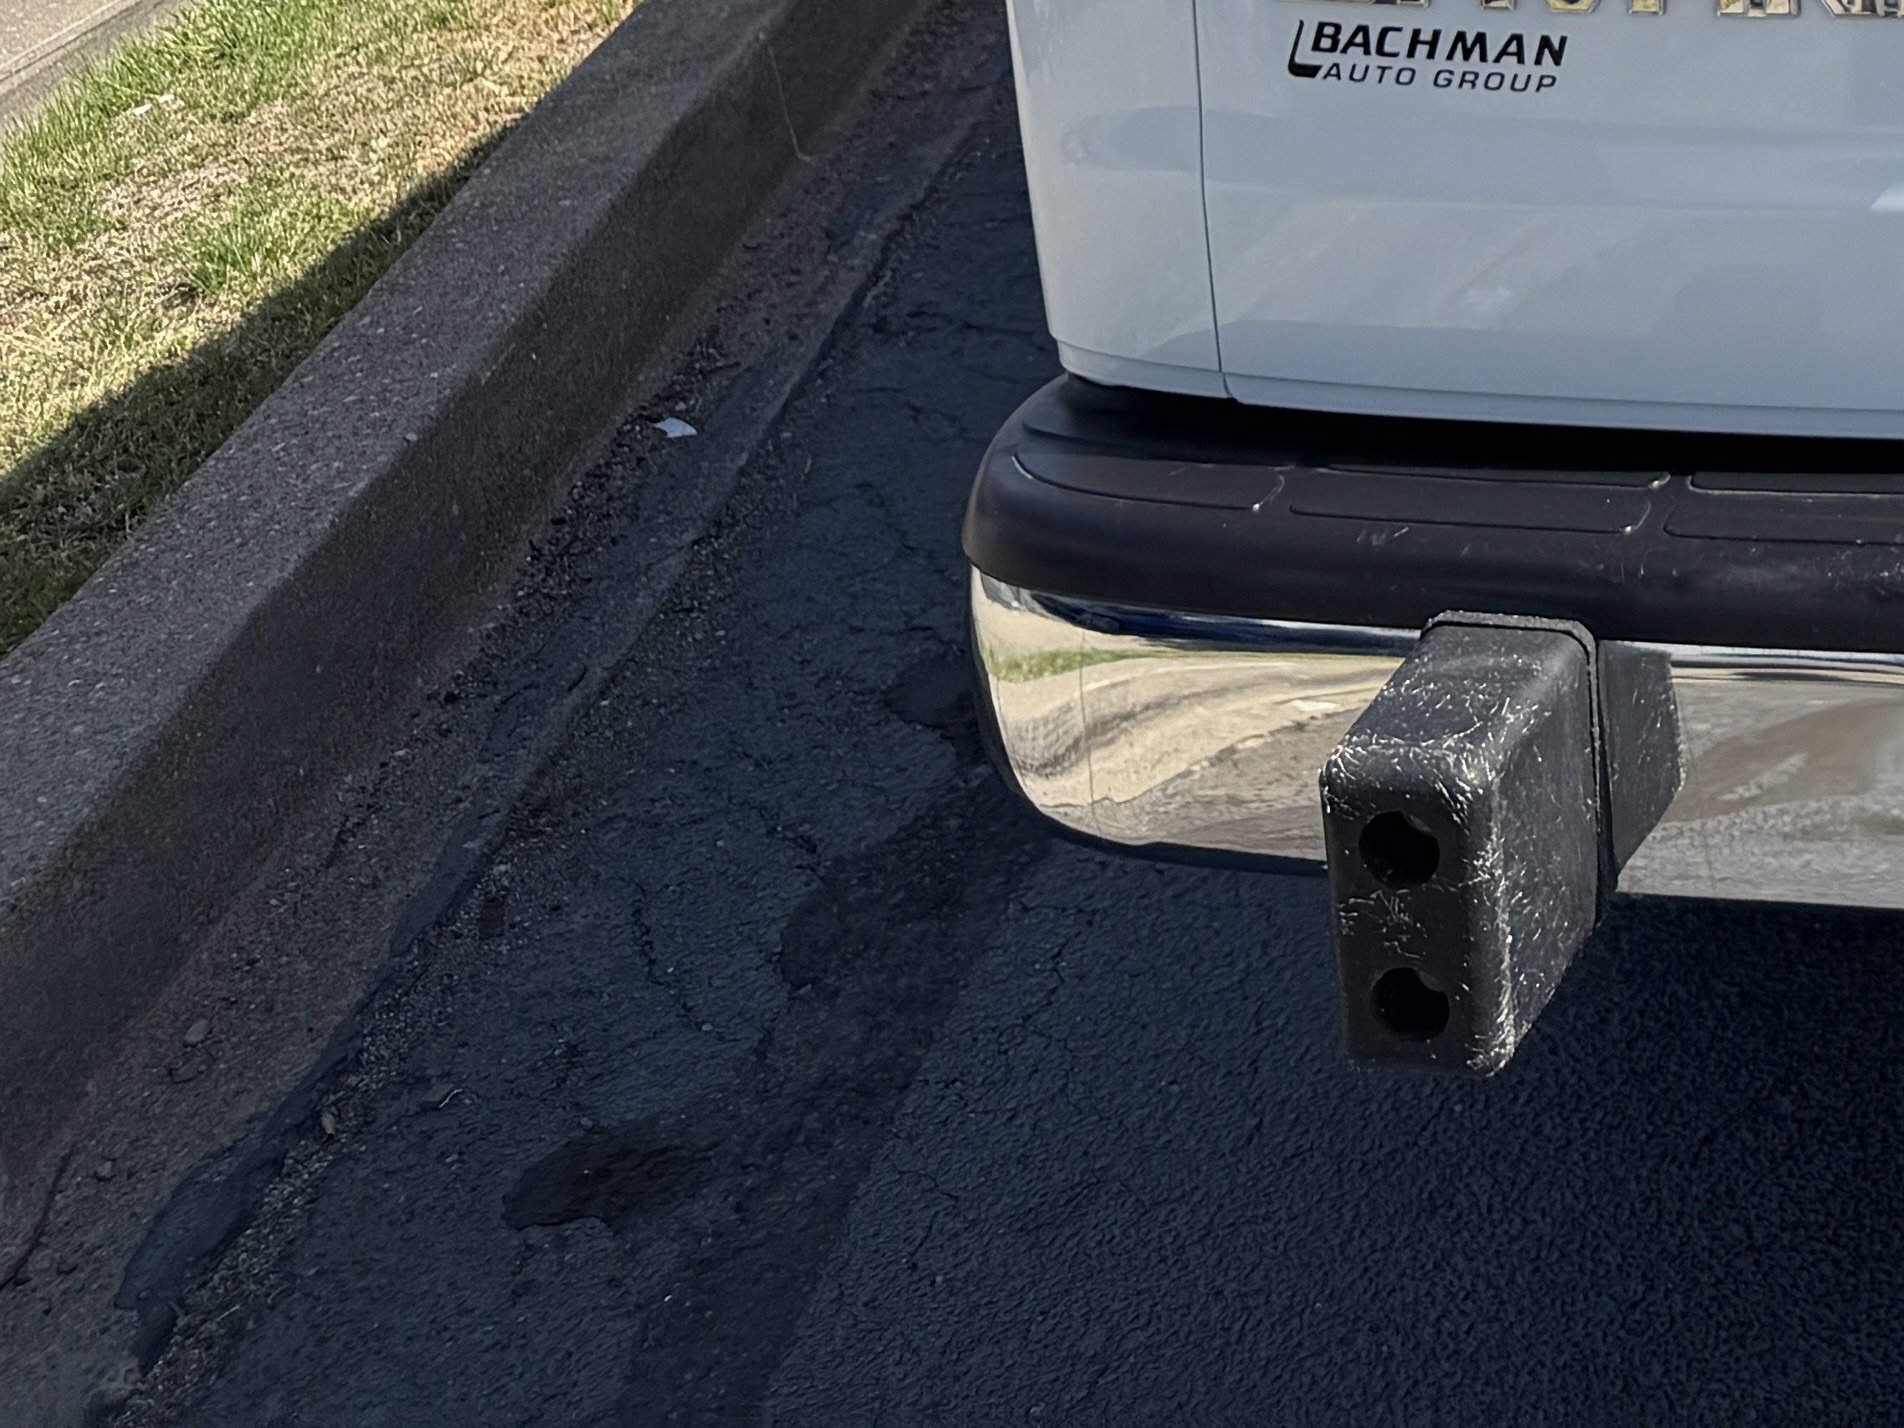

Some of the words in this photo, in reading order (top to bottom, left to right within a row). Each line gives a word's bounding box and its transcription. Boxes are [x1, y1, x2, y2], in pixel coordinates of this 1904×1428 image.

[1310, 21, 1568, 67] BACHMAN
[1322, 62, 1417, 86] AUTO
[1432, 69, 1558, 93] GROUP
